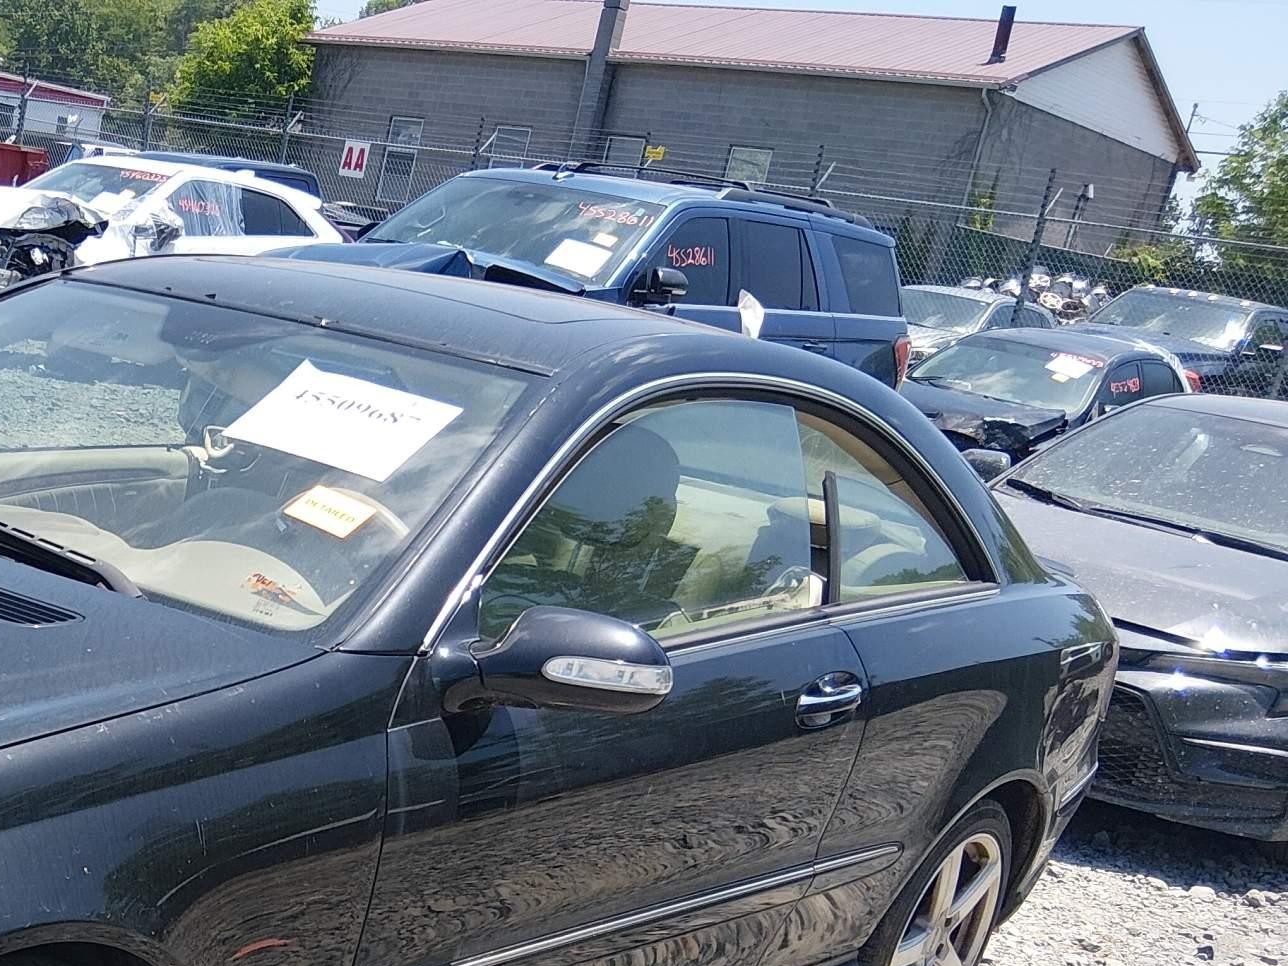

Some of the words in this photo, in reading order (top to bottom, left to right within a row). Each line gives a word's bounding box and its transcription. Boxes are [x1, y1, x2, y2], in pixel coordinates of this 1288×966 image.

[342, 146, 366, 172] AA
[579, 202, 655, 228] 45528611
[667, 244, 715, 267] 45528611
